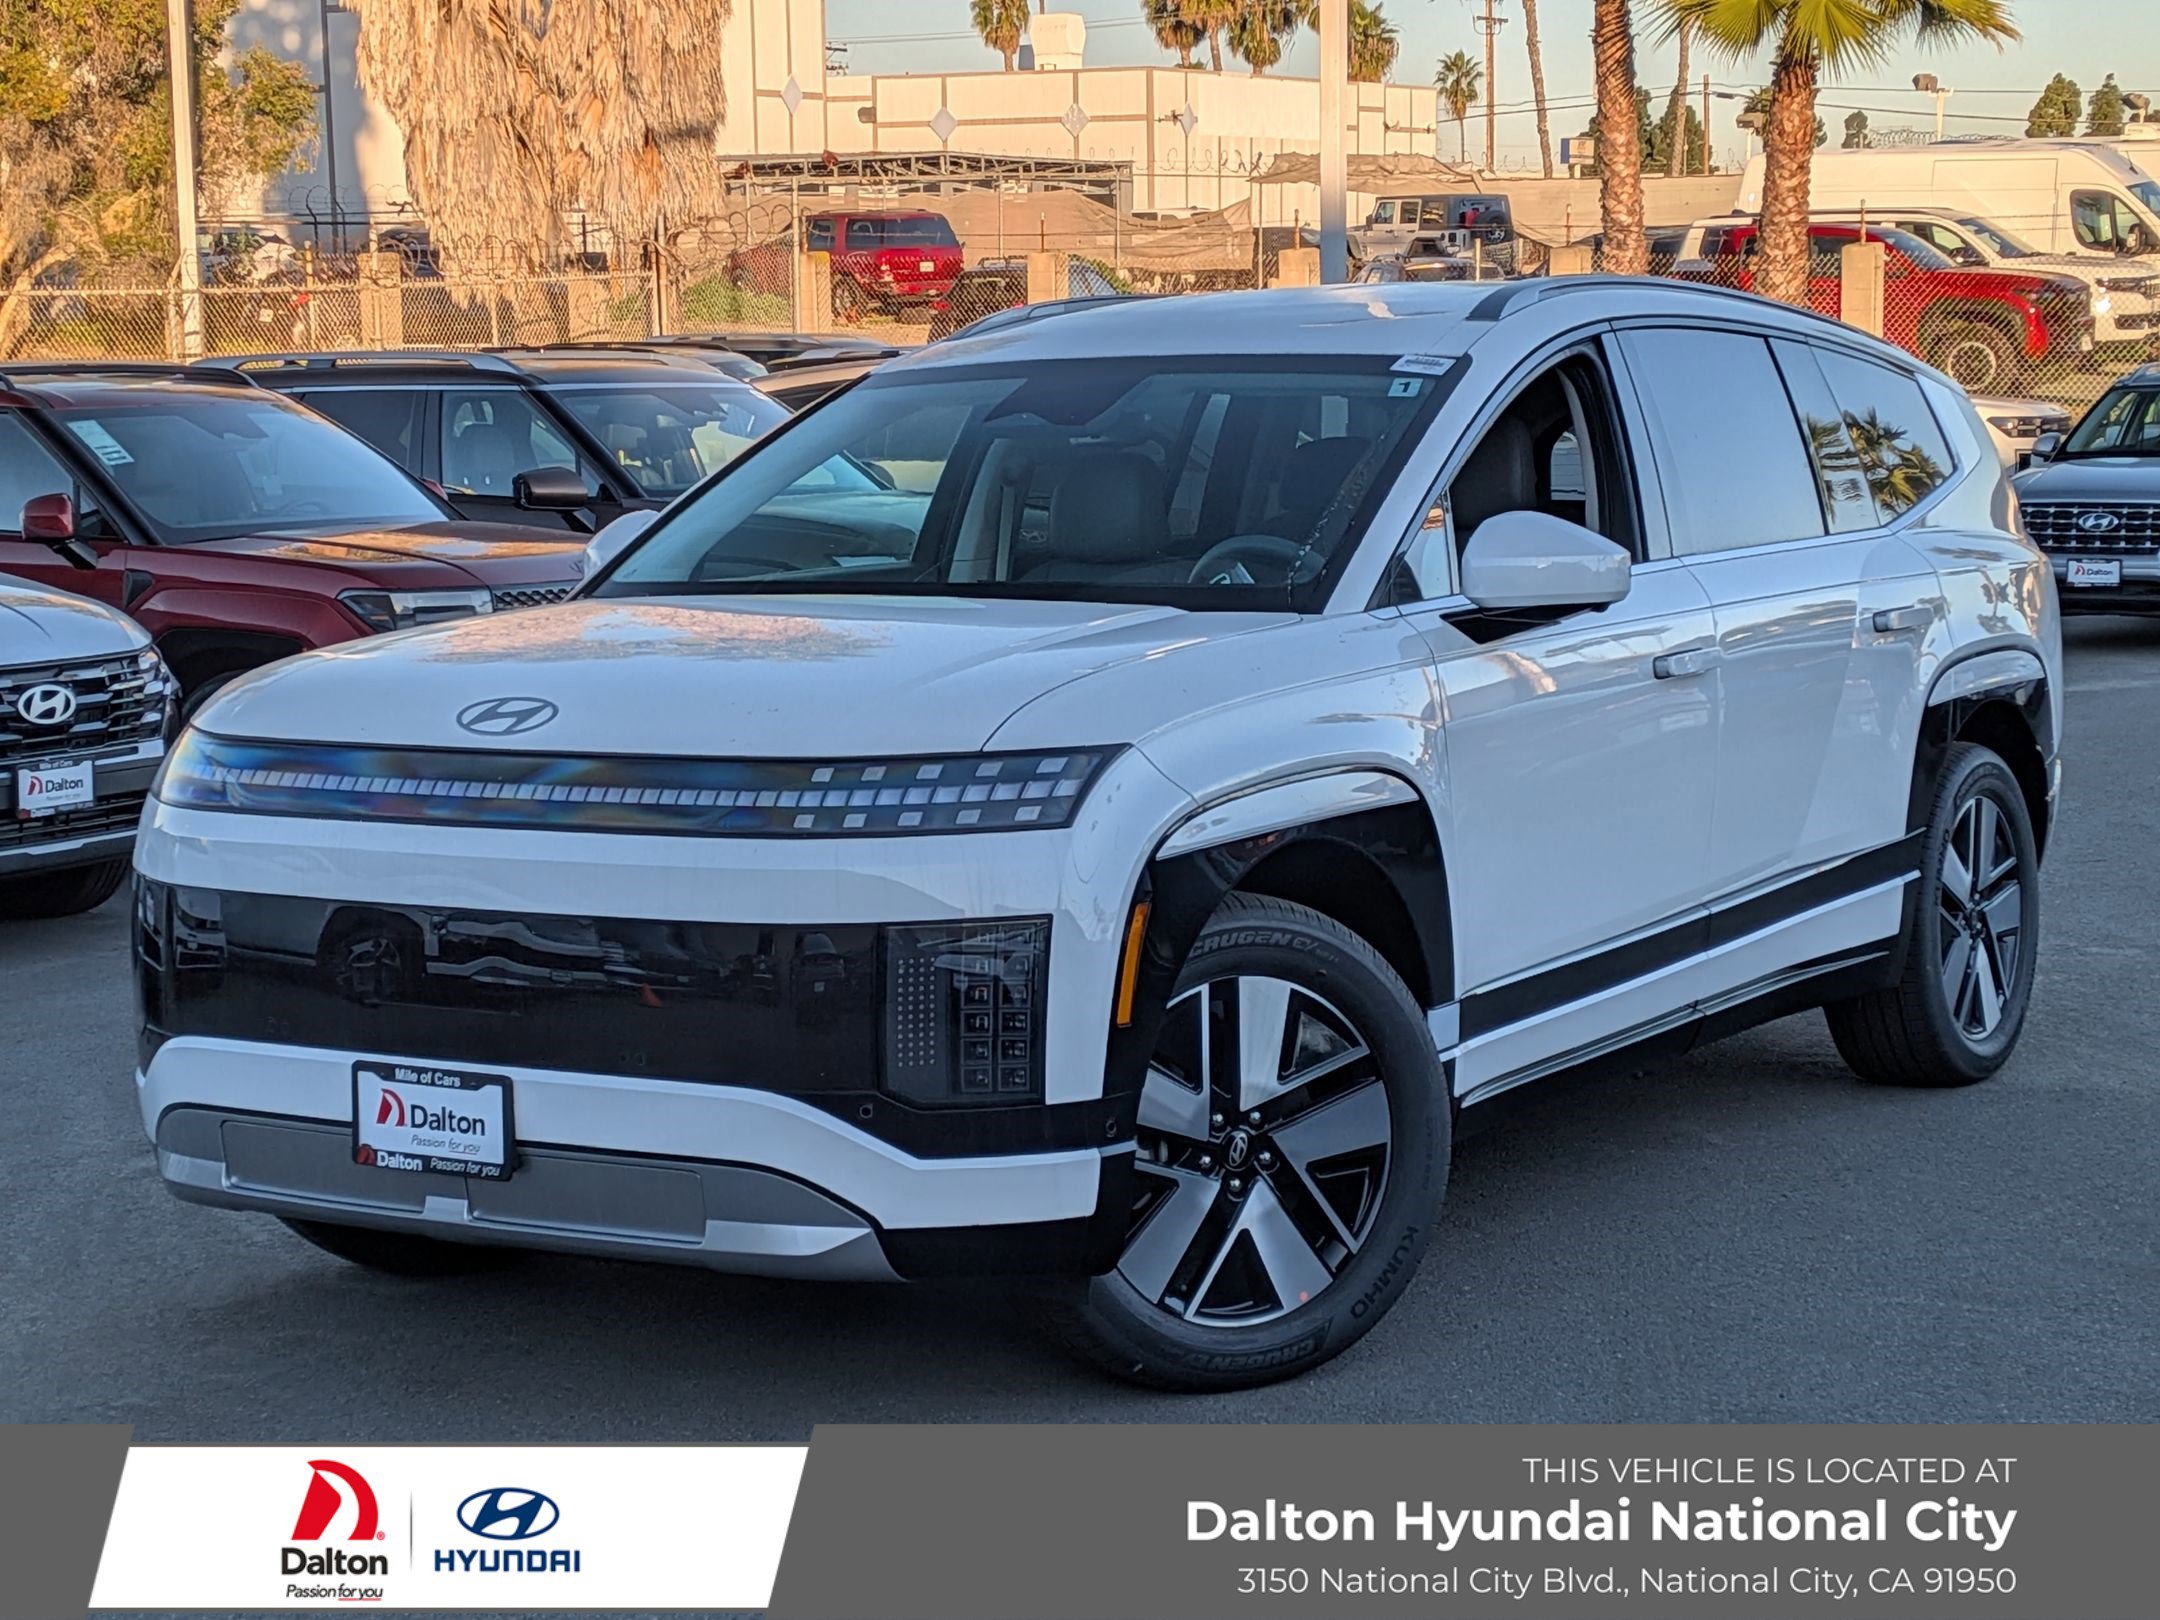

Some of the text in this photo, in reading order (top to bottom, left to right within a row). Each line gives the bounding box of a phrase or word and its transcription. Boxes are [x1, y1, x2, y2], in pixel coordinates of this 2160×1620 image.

[45, 778, 83, 793] Dalton
[395, 1067, 461, 1087] Mile of Cars
[410, 1104, 485, 1136] Dalton
[411, 1135, 481, 1153] Passion for you
[376, 1151, 501, 1177] Dalton Passion for you
[1350, 1225, 1419, 1318] KUMHO
